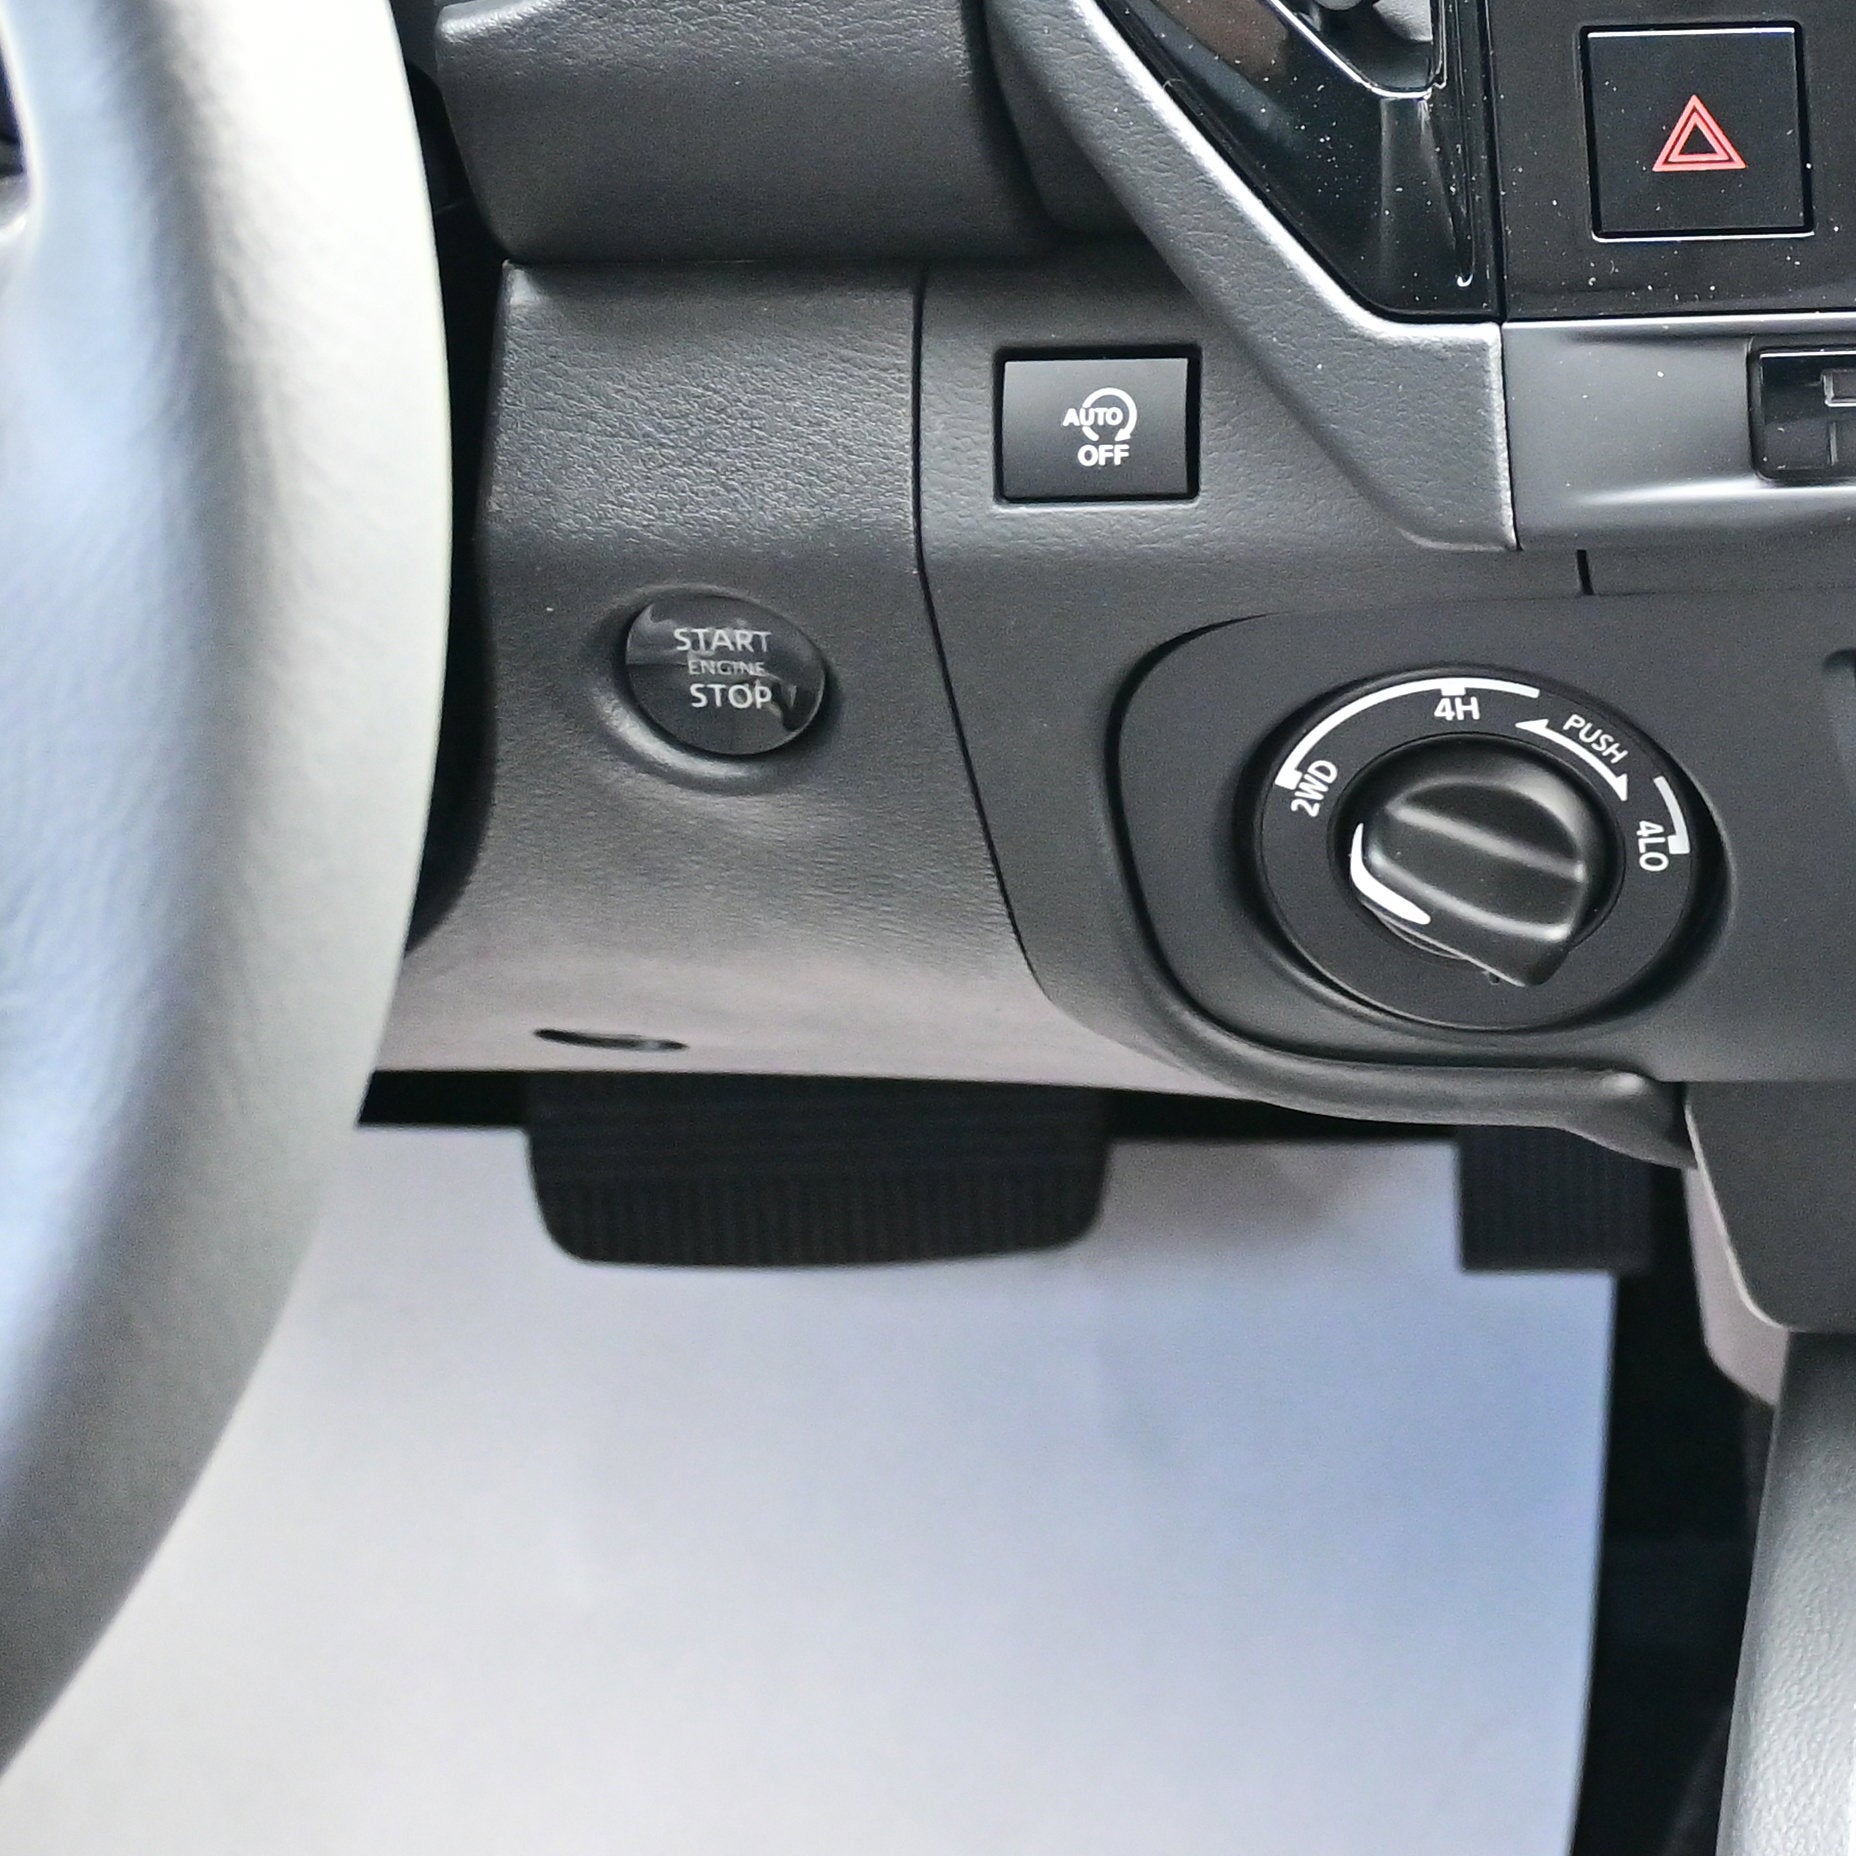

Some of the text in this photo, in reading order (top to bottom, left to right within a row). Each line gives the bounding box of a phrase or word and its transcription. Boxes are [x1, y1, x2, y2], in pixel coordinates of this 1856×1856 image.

[1062, 405, 1123, 427] AUTO
[1077, 444, 1129, 467] OFF
[674, 628, 771, 653] START
[688, 659, 765, 677] ENGINE
[690, 683, 772, 708] STOP
[1434, 697, 1480, 721] 4H
[1563, 714, 1628, 763] PUSH
[1290, 759, 1338, 817] 2WD
[1636, 819, 1670, 872] 4LO
